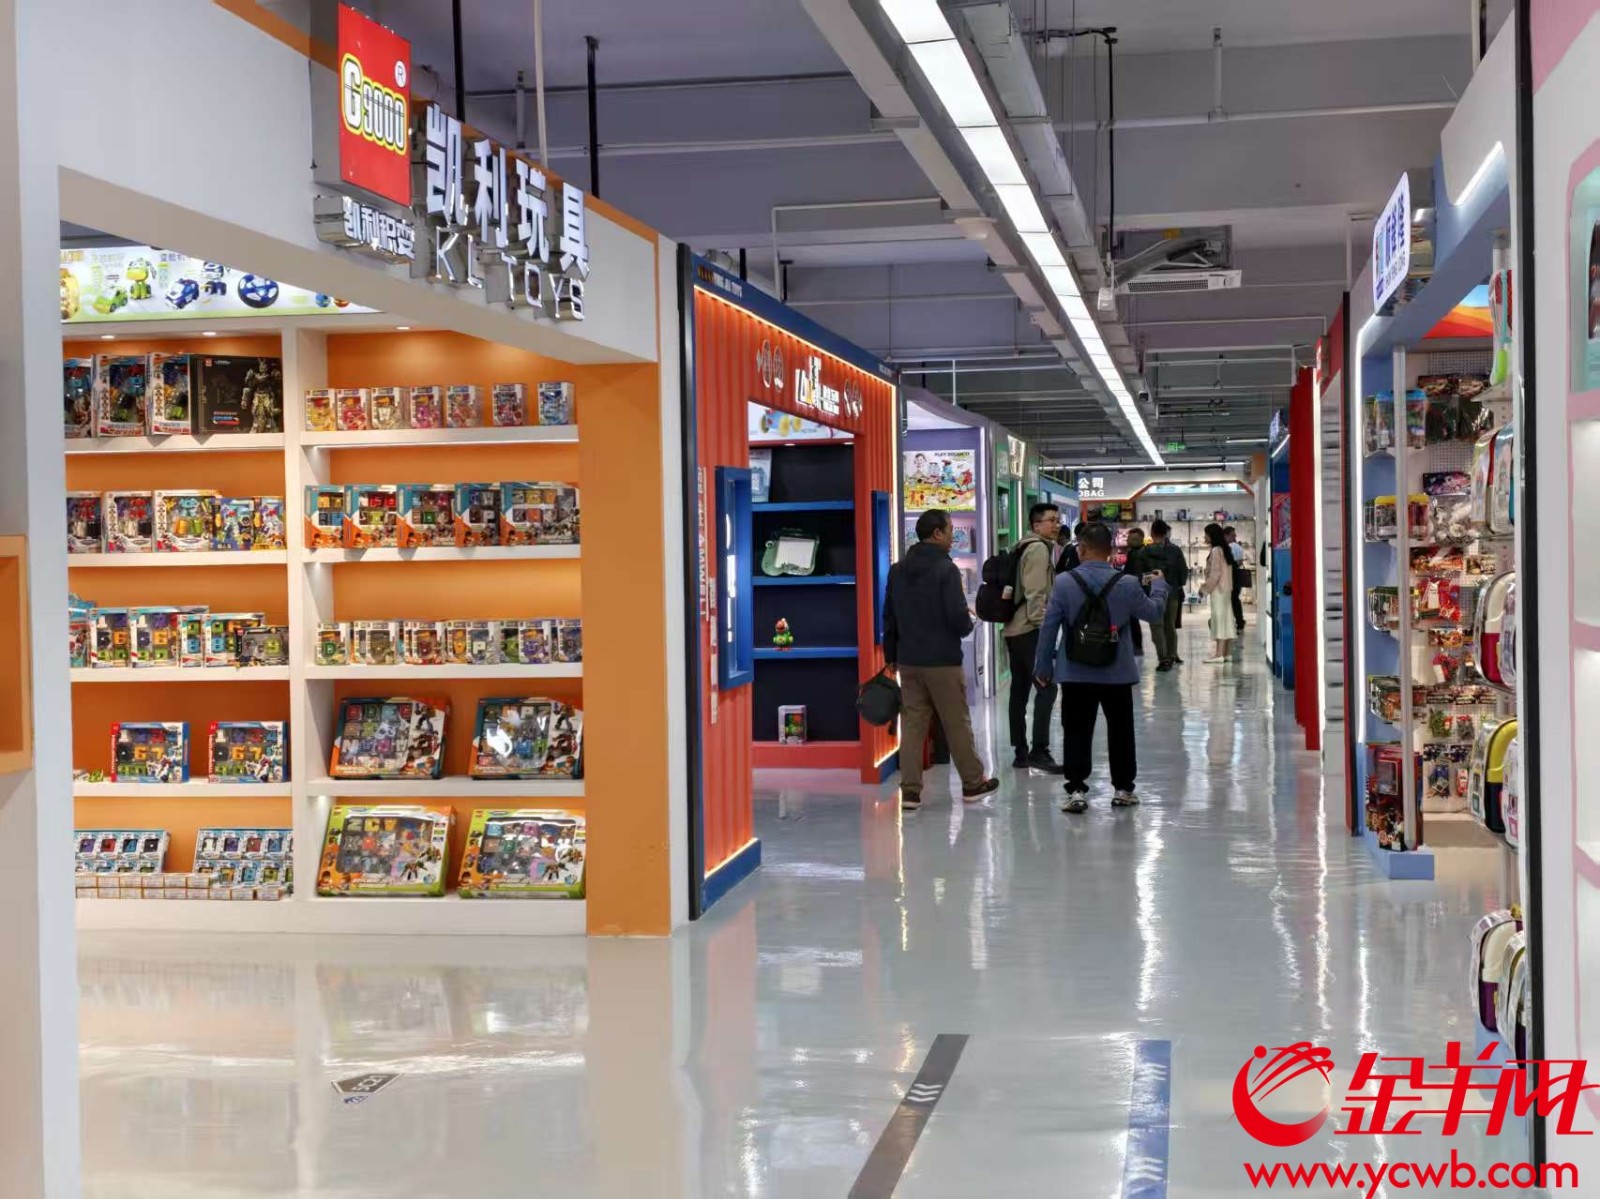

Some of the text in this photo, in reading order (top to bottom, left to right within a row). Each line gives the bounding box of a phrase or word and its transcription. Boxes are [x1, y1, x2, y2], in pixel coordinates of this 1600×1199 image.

[343, 55, 406, 153] G9000
[426, 103, 590, 281] 凯利玩具
[436, 226, 584, 320] KL TOYS
[1078, 477, 1104, 489] 公司
